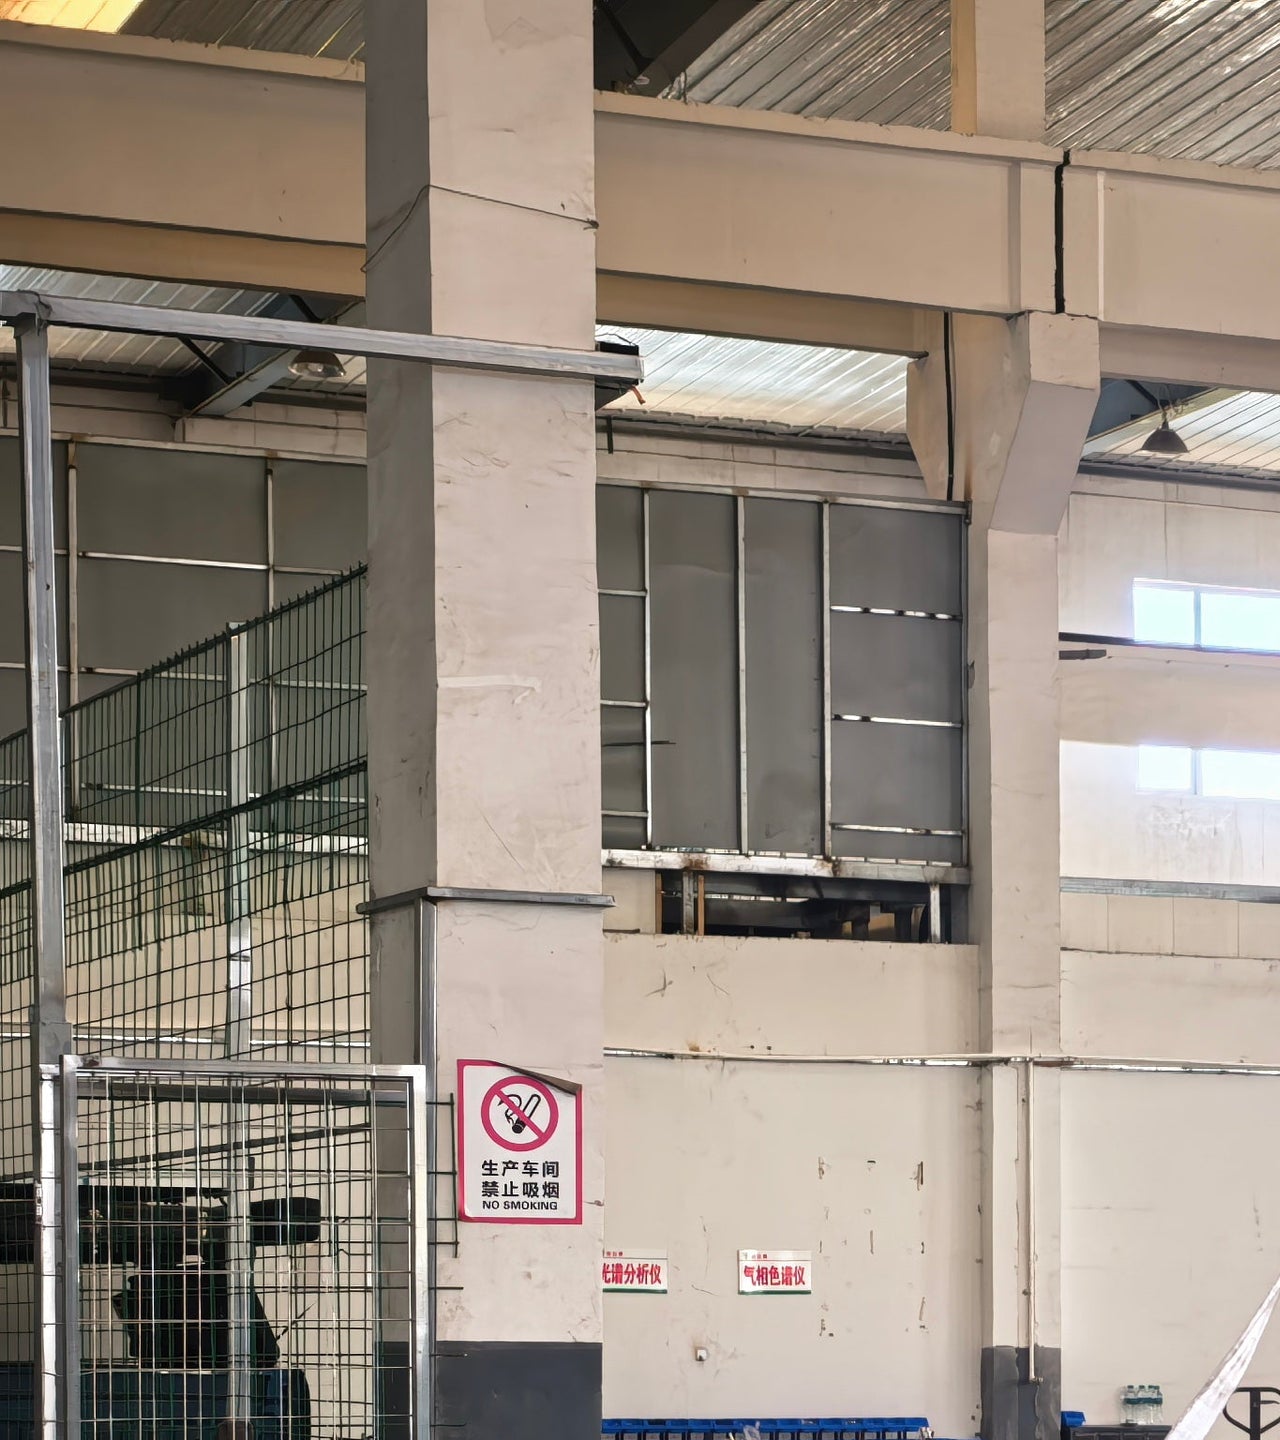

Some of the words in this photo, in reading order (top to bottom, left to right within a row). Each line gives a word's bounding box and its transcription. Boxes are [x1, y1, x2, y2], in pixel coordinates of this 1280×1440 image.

[481, 1160, 560, 1178] 生产车间
[481, 1181, 560, 1199] 禁止吸烟
[482, 1201, 500, 1210] NO
[503, 1201, 558, 1210] SMOKING
[743, 1265, 806, 1286] 气相色谱仪
